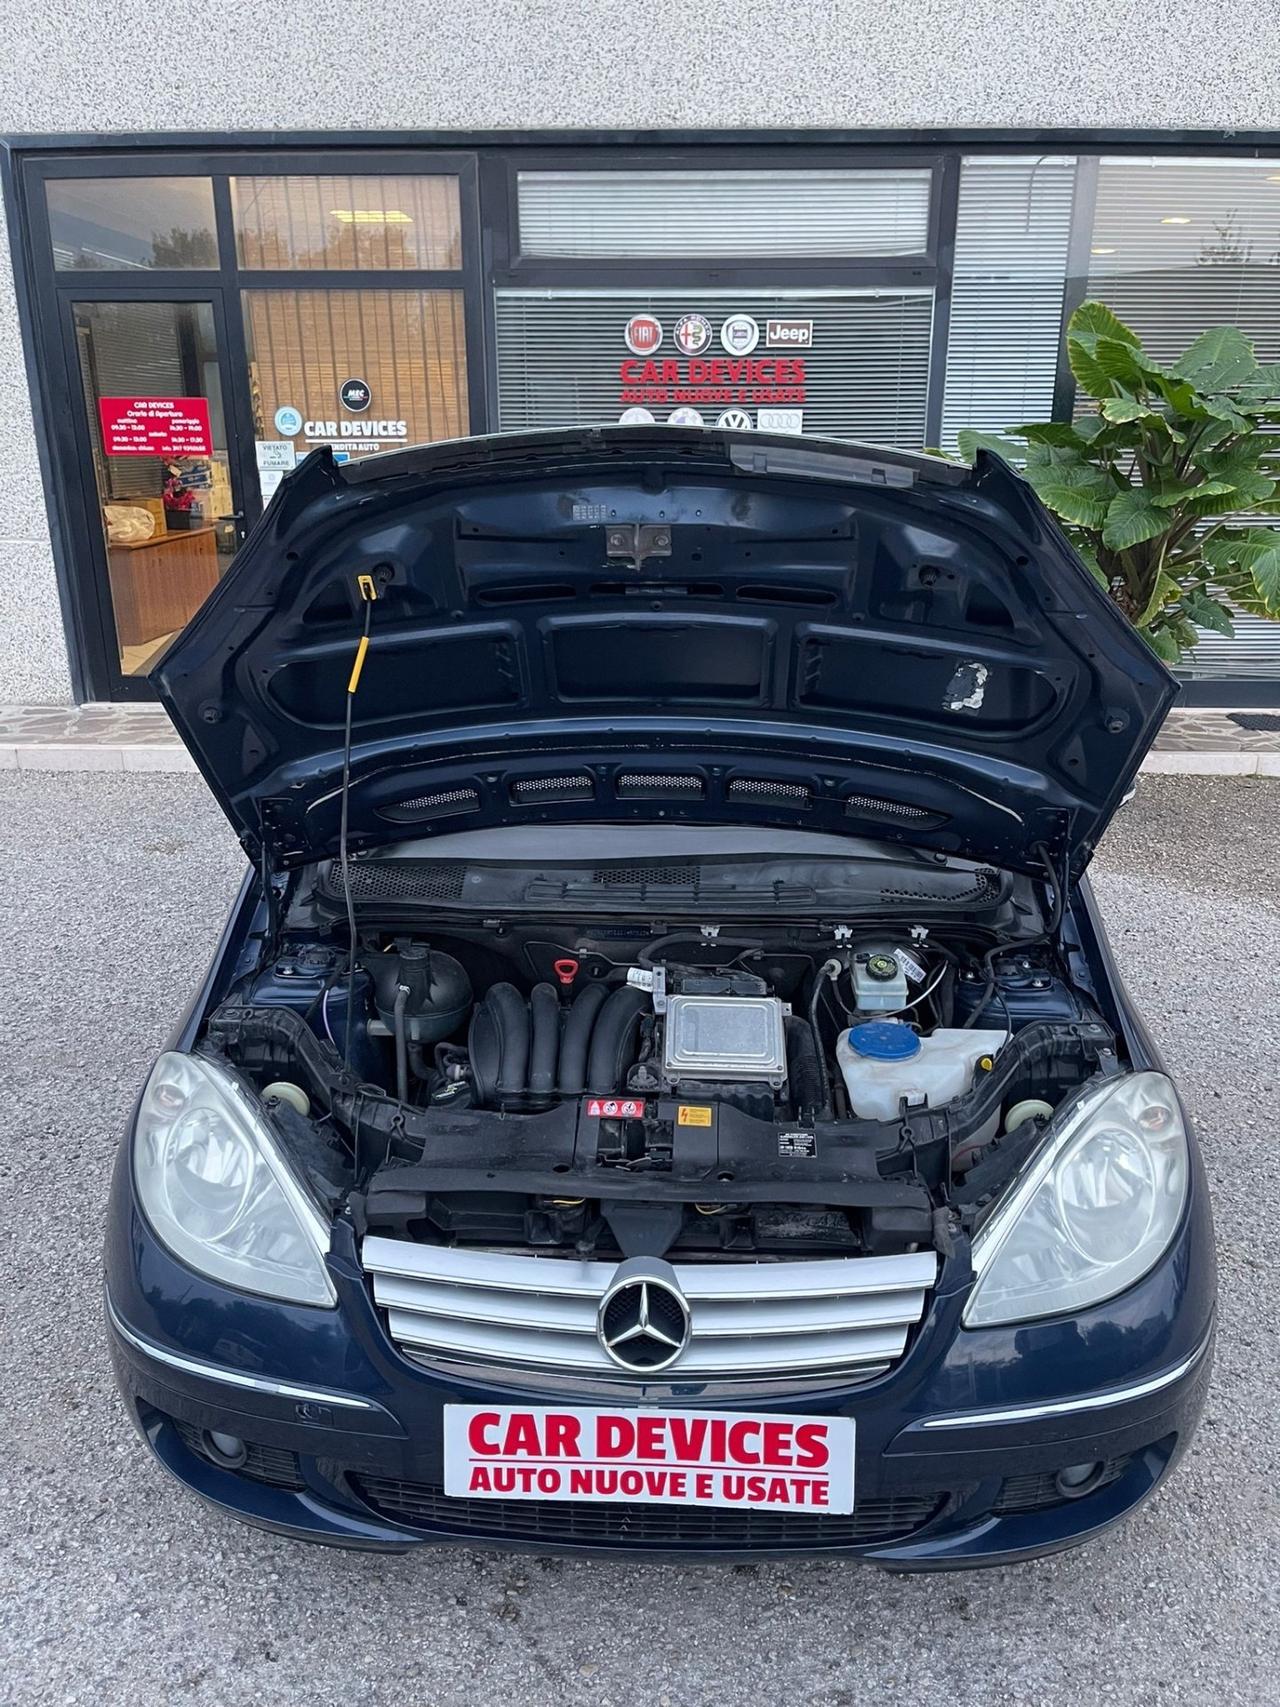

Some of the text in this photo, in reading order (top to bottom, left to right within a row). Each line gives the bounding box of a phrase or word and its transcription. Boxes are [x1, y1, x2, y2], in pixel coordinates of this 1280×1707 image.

[633, 325, 654, 343] FIAT
[769, 324, 809, 344] Jeep
[619, 359, 806, 385] CAR DEVICES
[619, 389, 806, 404] AUTO NUOVE E USATE
[304, 421, 407, 437] CAR DEVICES
[358, 443, 380, 451] AUTO
[467, 1412, 830, 1469] CAR DEVICES
[468, 1466, 830, 1507] AUTO NUOVE E USATE
